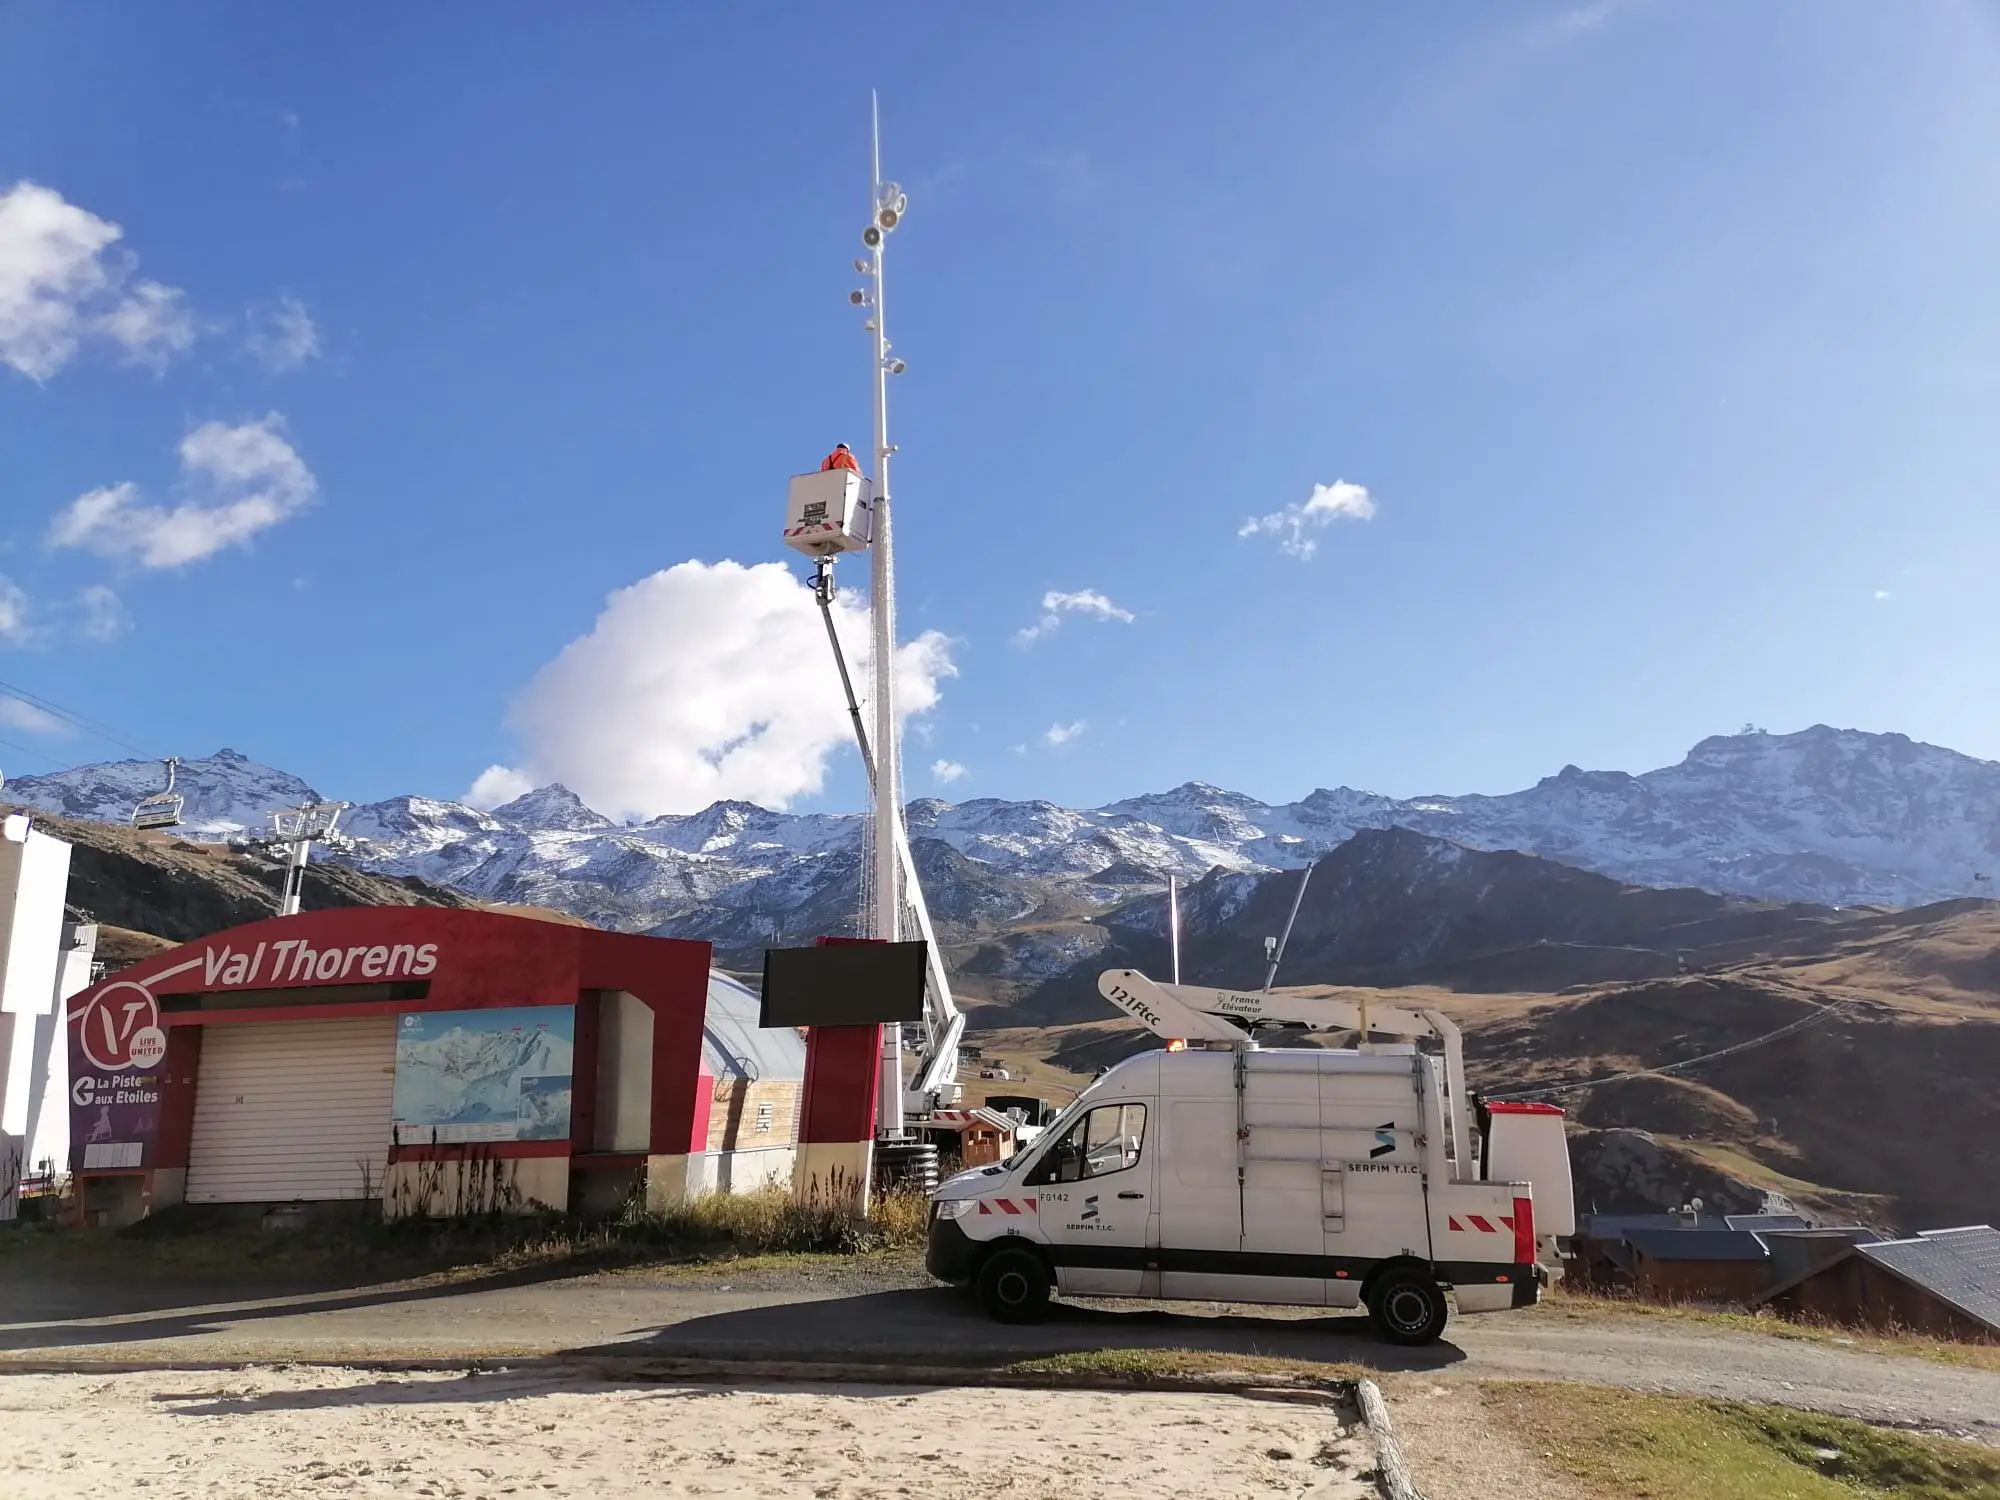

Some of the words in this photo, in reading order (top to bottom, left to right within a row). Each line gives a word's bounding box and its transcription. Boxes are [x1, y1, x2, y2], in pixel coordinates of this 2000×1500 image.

[204, 941, 267, 986] Val
[270, 939, 439, 982] Thorens
[1229, 994, 1260, 1005] France
[139, 1037, 157, 1046] LIVE
[131, 1047, 163, 1056] UNITED
[97, 1078, 109, 1089] La
[112, 1074, 142, 1089] Piste
[95, 1094, 113, 1105] aux
[116, 1089, 159, 1104] Etoiles
[1348, 1163, 1390, 1174] SERFIM
[1394, 1165, 1422, 1175] T.I.C.
[1066, 1223, 1094, 1231] SERFIM
[1095, 1224, 1115, 1232] T.I.C.
